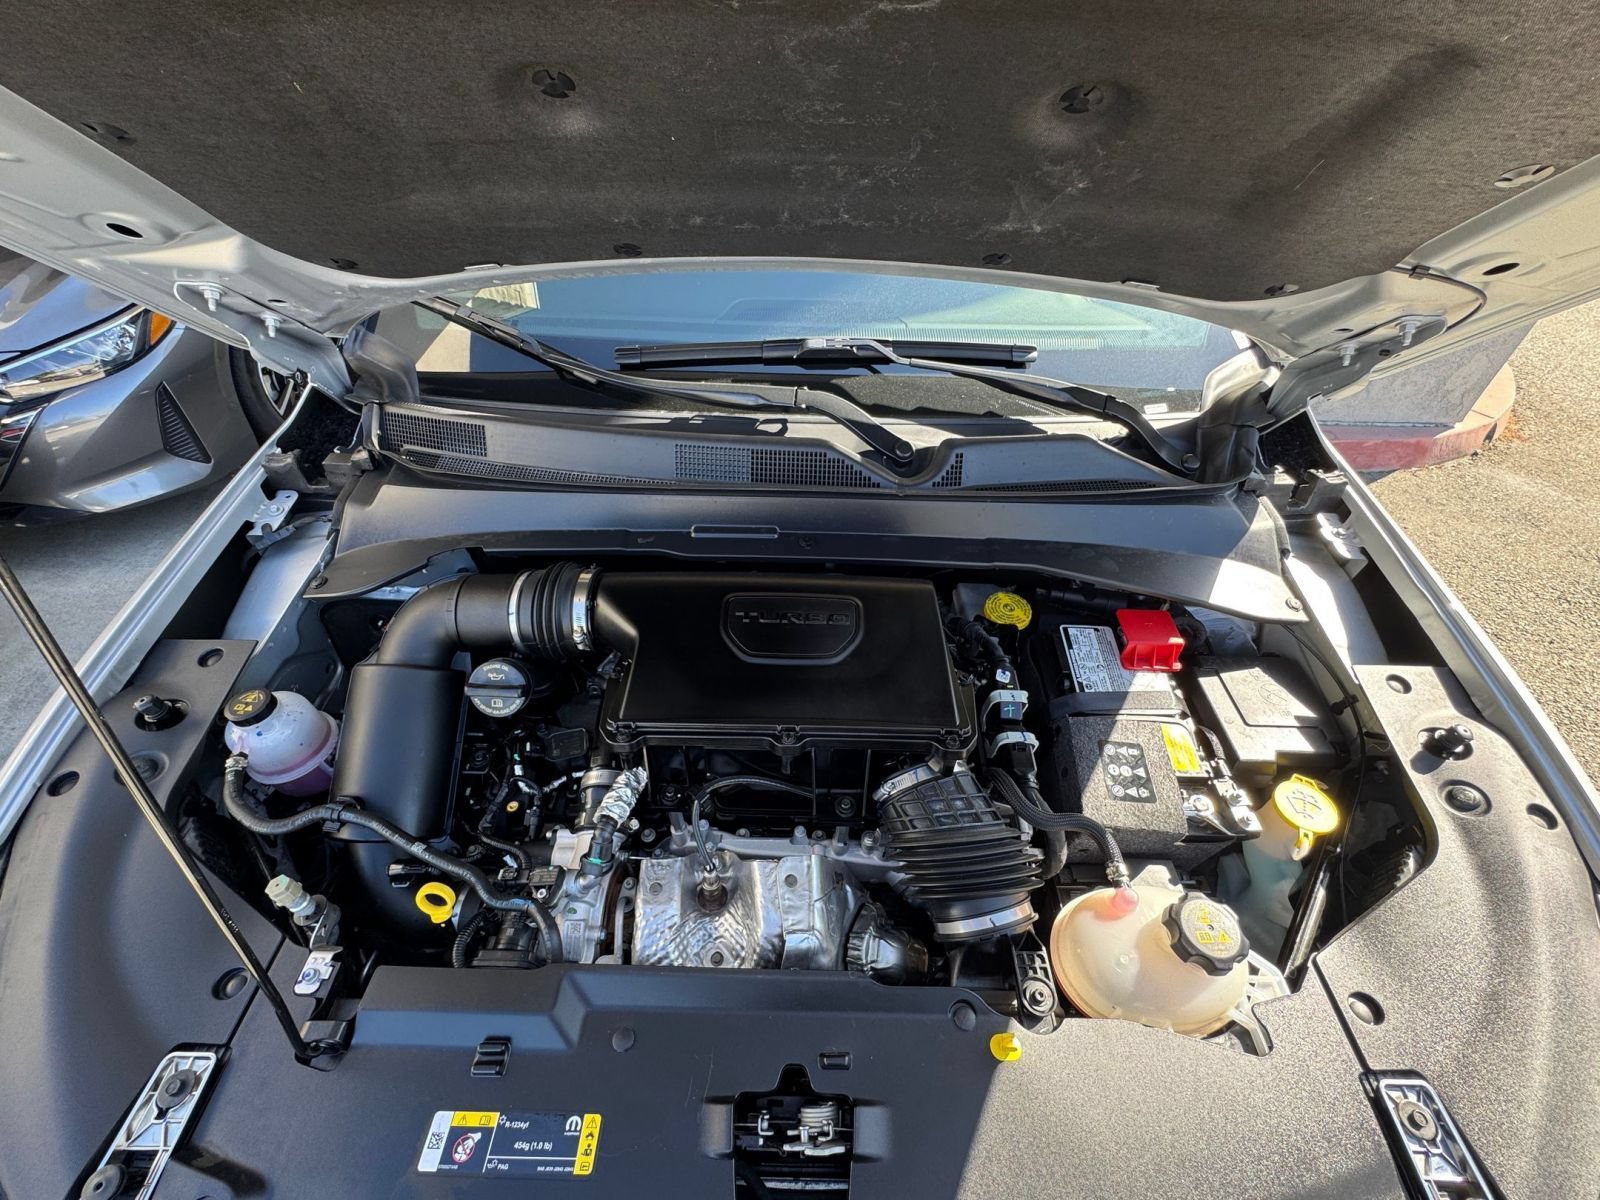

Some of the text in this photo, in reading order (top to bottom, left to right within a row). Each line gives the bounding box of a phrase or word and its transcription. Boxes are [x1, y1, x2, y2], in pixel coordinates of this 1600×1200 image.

[735, 611, 851, 625] TURBO
[504, 1121, 530, 1130] R-1234yf
[513, 1141, 530, 1151] 454g
[530, 1141, 543, 1151] (1.0
